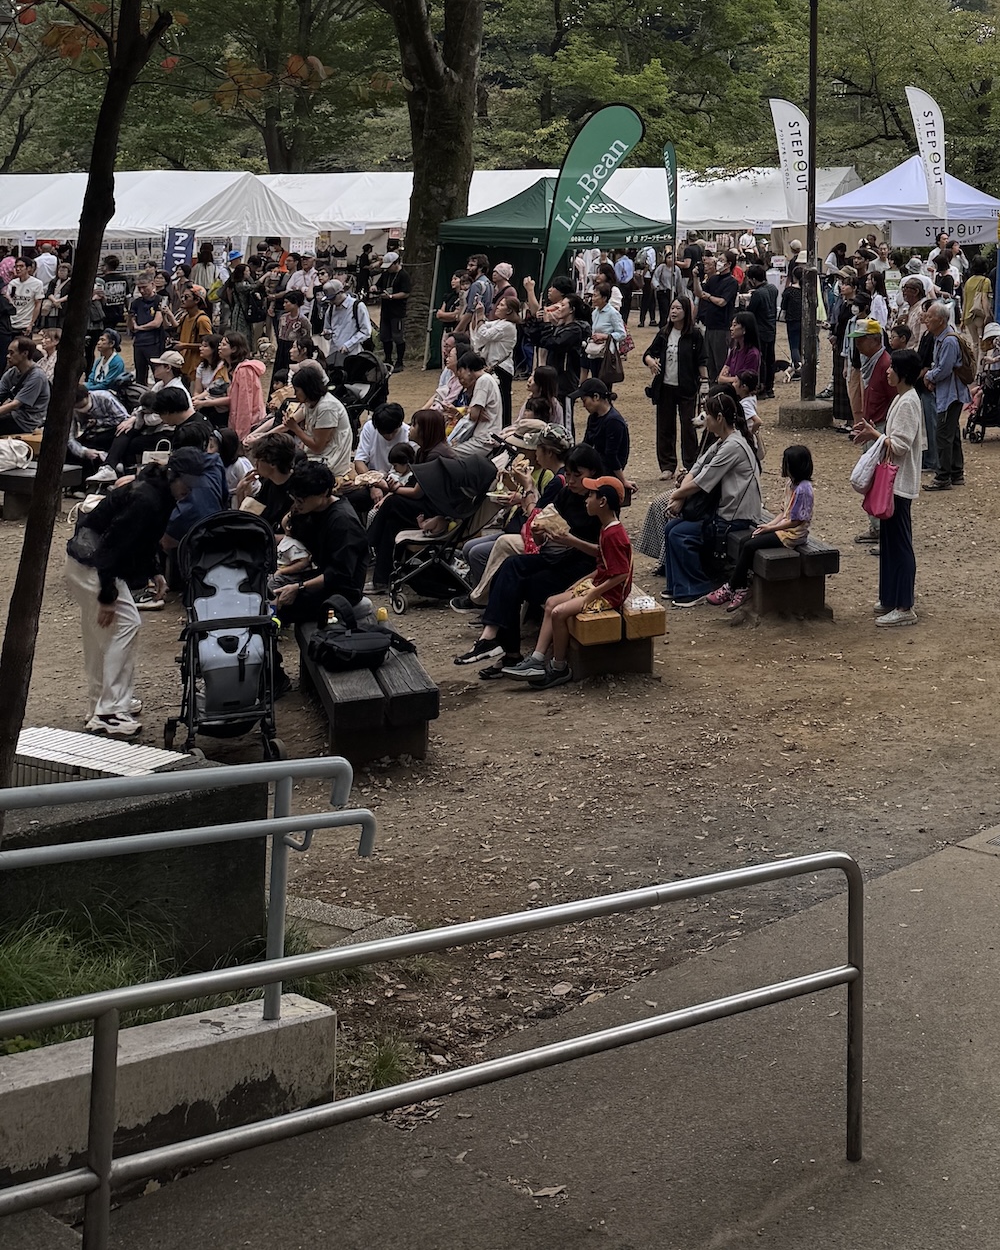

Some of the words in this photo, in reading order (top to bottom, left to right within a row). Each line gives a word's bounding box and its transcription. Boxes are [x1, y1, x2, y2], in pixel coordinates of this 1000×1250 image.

[788, 121, 808, 192] STEPOUT
[923, 110, 943, 185] STEPOUT
[555, 139, 629, 232] L.L.Bean
